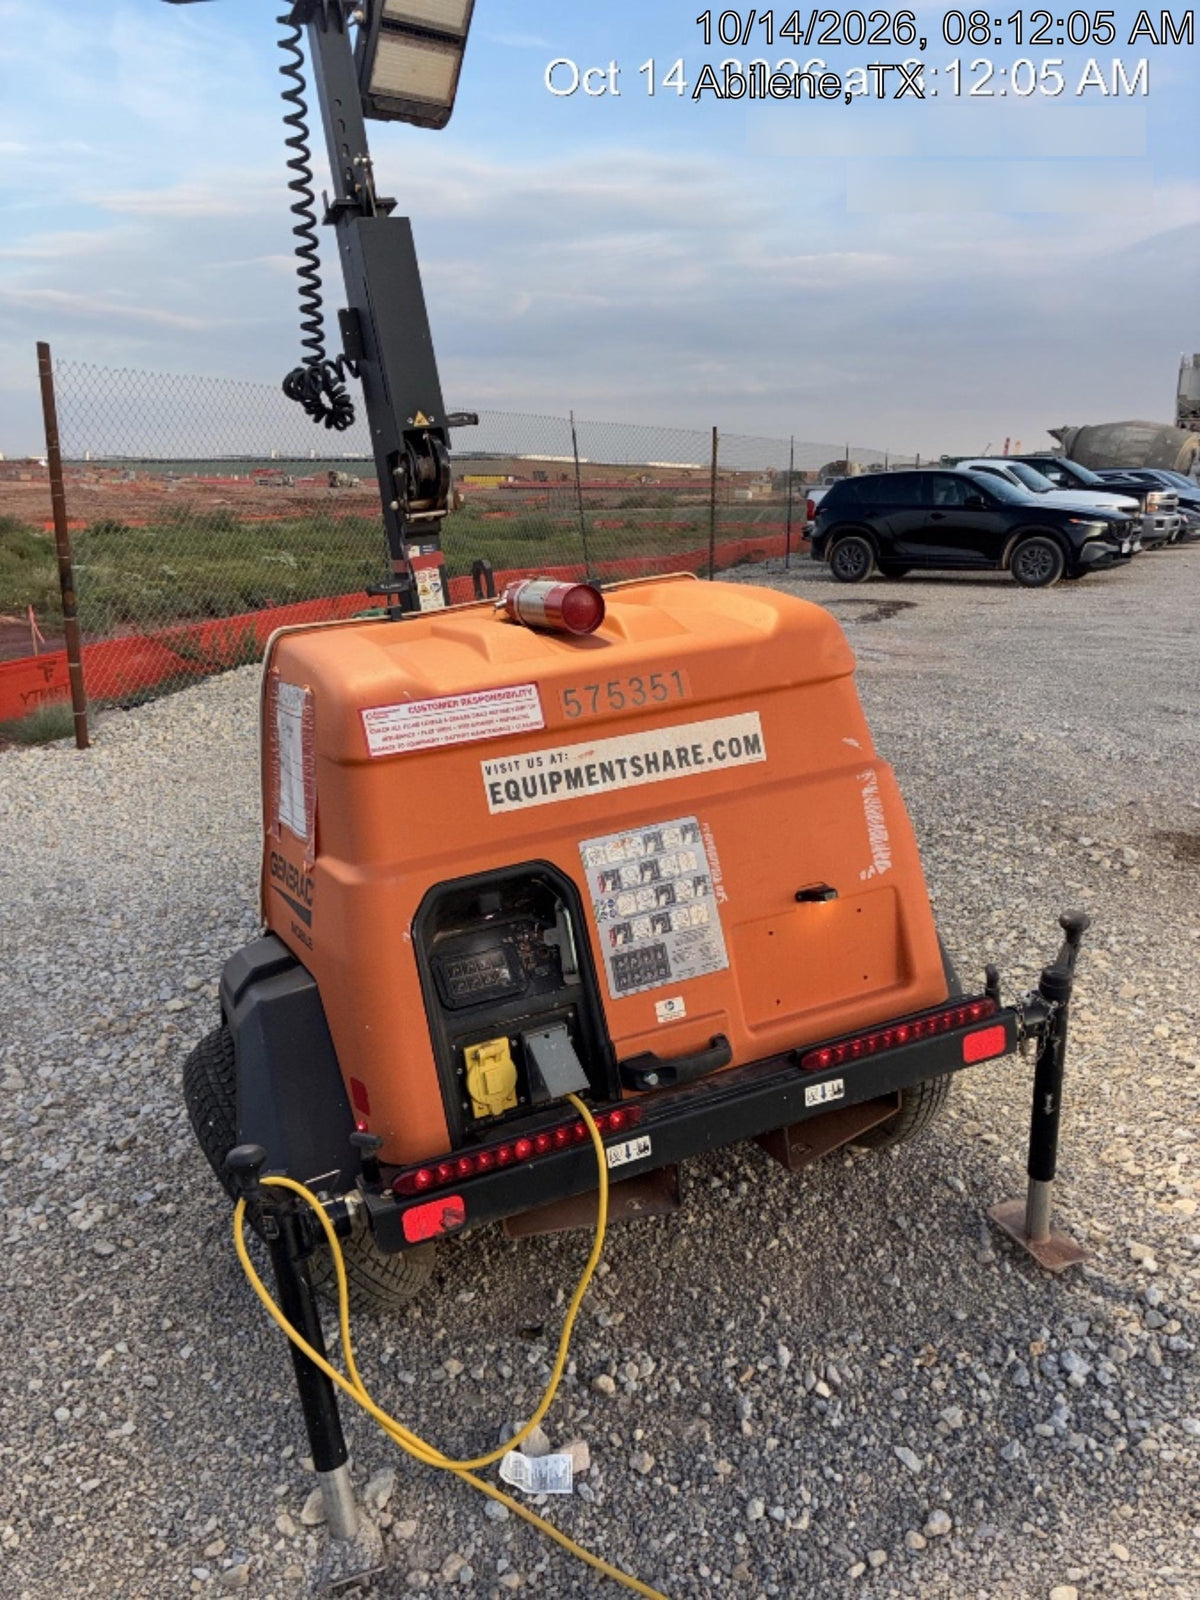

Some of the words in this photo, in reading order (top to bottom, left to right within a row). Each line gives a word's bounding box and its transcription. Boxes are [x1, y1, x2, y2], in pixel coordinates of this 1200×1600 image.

[408, 700, 459, 715] CUSTOMER
[460, 688, 533, 706] RESPONSIBILITY
[563, 670, 685, 718] 575351
[485, 760, 520, 776] VISIT
[526, 757, 544, 769] US
[550, 752, 568, 765] AT:
[489, 733, 762, 806] EQUIPMENTSHARE.COM
[271, 850, 314, 908] GENERAC
